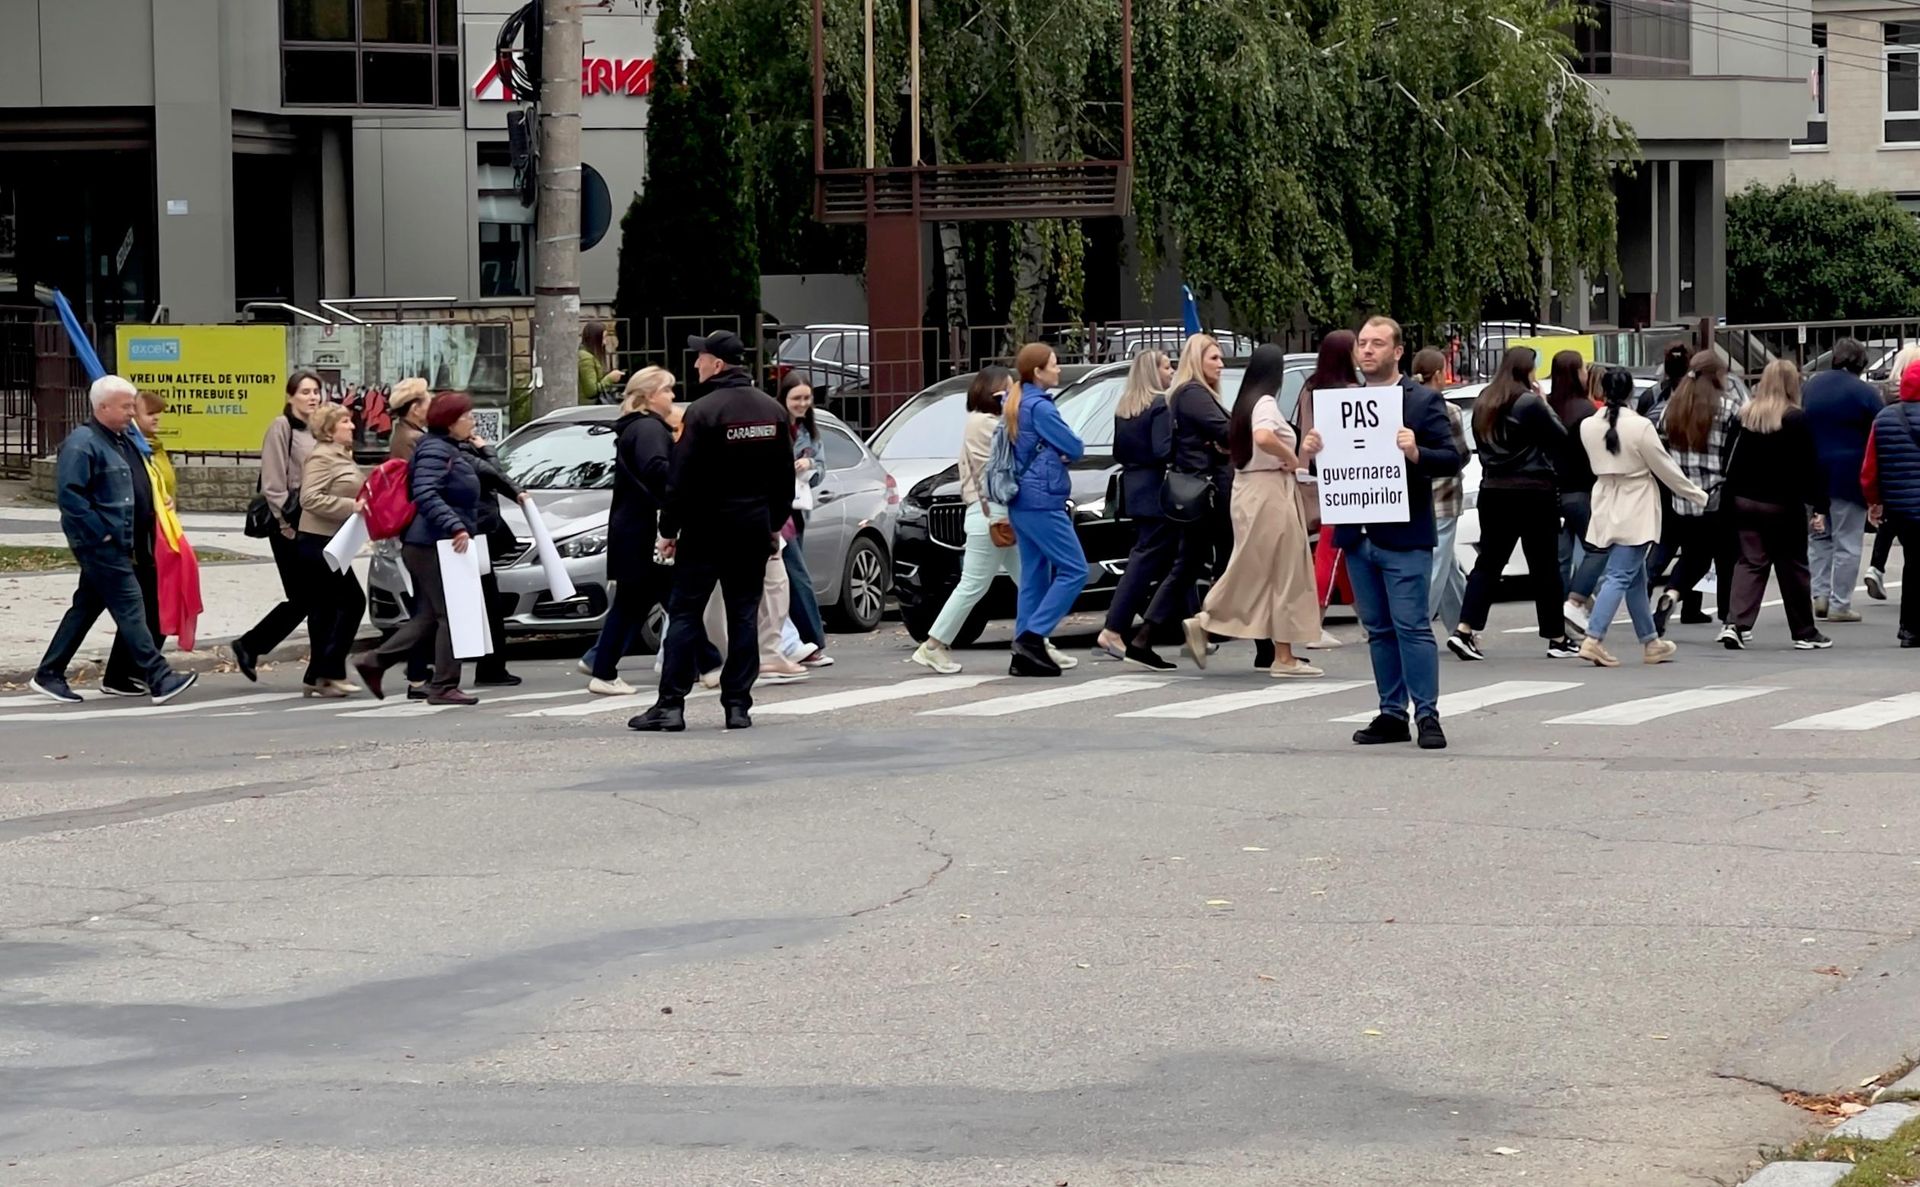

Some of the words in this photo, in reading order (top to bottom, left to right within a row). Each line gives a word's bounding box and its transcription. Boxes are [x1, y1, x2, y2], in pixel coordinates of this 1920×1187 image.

[130, 374, 155, 383] VREI
[158, 374, 173, 383] UN
[176, 374, 216, 384] ALTFEL
[218, 374, 232, 384] DE
[235, 374, 276, 384] VIITOR?
[189, 389, 235, 399] TREBUIE
[237, 389, 248, 401] ȘI
[1341, 400, 1379, 429] PAS
[1323, 465, 1401, 485] guvernarea
[1325, 487, 1403, 509] scumpirilor
